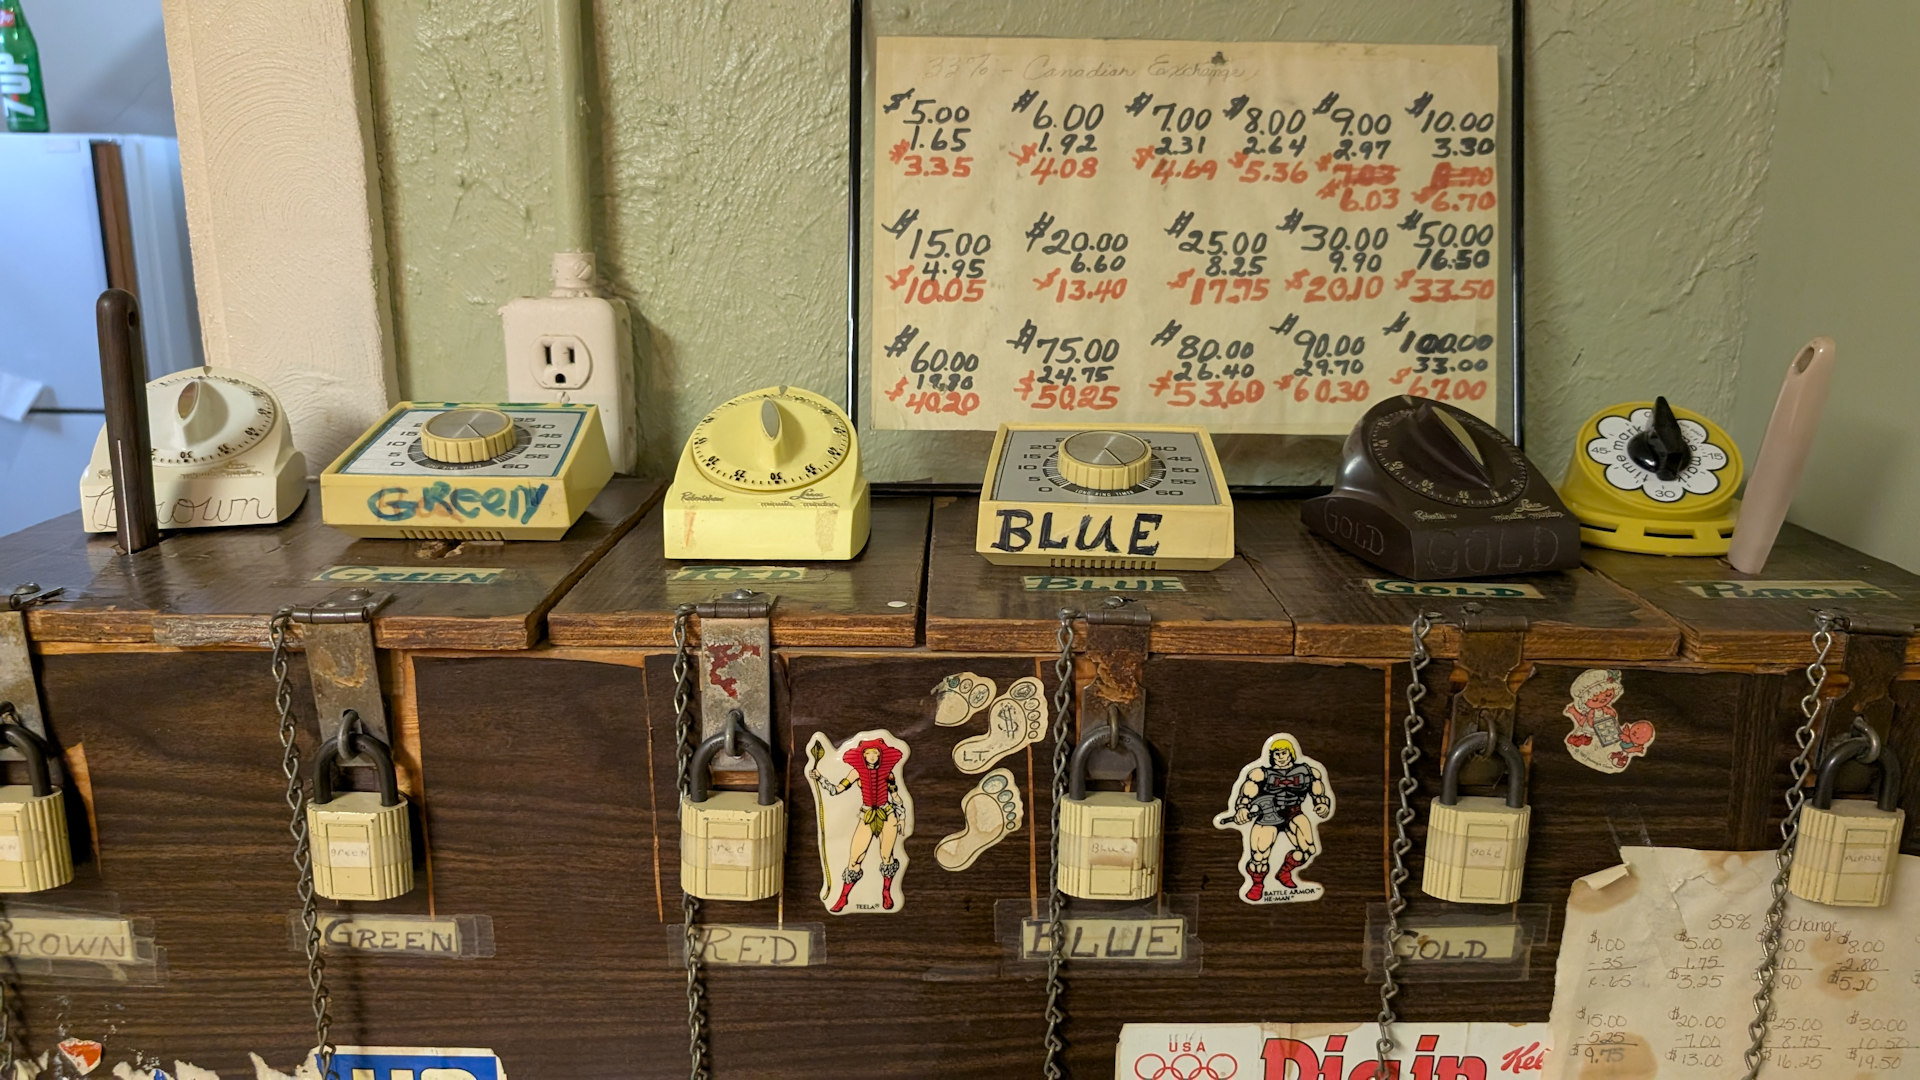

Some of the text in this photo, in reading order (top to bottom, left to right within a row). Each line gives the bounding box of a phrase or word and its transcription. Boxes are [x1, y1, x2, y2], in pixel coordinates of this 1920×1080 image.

[1023, 54, 1136, 80] Canadian
[883, 88, 1495, 136] $5.00 $6.00 $7.00 $8.00 $9.00 $10.00
[910, 125, 1495, 161] 1.65 1.92 2.31 2.64 2.97 3.30
[888, 139, 974, 177] $3.35
[1008, 142, 1098, 185] $4.08
[1132, 145, 1217, 184] $4.69
[1228, 151, 1308, 184] $5.36
[1316, 179, 1496, 213] $6.03 $6.70
[882, 208, 1494, 259] $15.00 $20.00 $25.00 $30.00 $50.00
[922, 249, 1490, 281] 4.95 6.60 8.25 9.90 16.50
[885, 265, 1495, 305] $10.05 $13.40 $17.75 $20.10 $33.50
[884, 311, 1494, 373] $60.00 $75.00 $80.00 $90.00 $100.00
[1037, 366, 1114, 386] 24.75
[1173, 361, 1254, 382] 26.40
[1293, 359, 1364, 377] 29.70
[1412, 357, 1488, 374] 33.00
[885, 376, 980, 415] $40.20
[1014, 370, 1120, 411] $50.25
[1148, 370, 1265, 409] $53.60
[1274, 374, 1370, 404] $60.30
[1654, 490, 1677, 499] 30
[990, 509, 1163, 556] BLUE
[1323, 498, 1384, 556] GOLD
[1427, 527, 1559, 576] GOLD
[1027, 576, 1181, 591] BLUE
[1374, 580, 1526, 598] GOLD
[325, 919, 453, 952] GREEN
[1674, 929, 1722, 950] $5.00
[1708, 913, 1839, 941] 35% xchange
[699, 928, 798, 965] RED
[1395, 929, 1488, 960] GOLD
[1667, 967, 1723, 989] $3.25
[1576, 1006, 1628, 1028] $15.00
[1667, 1006, 1726, 1028] $20.00
[1168, 1041, 1206, 1053] USA
